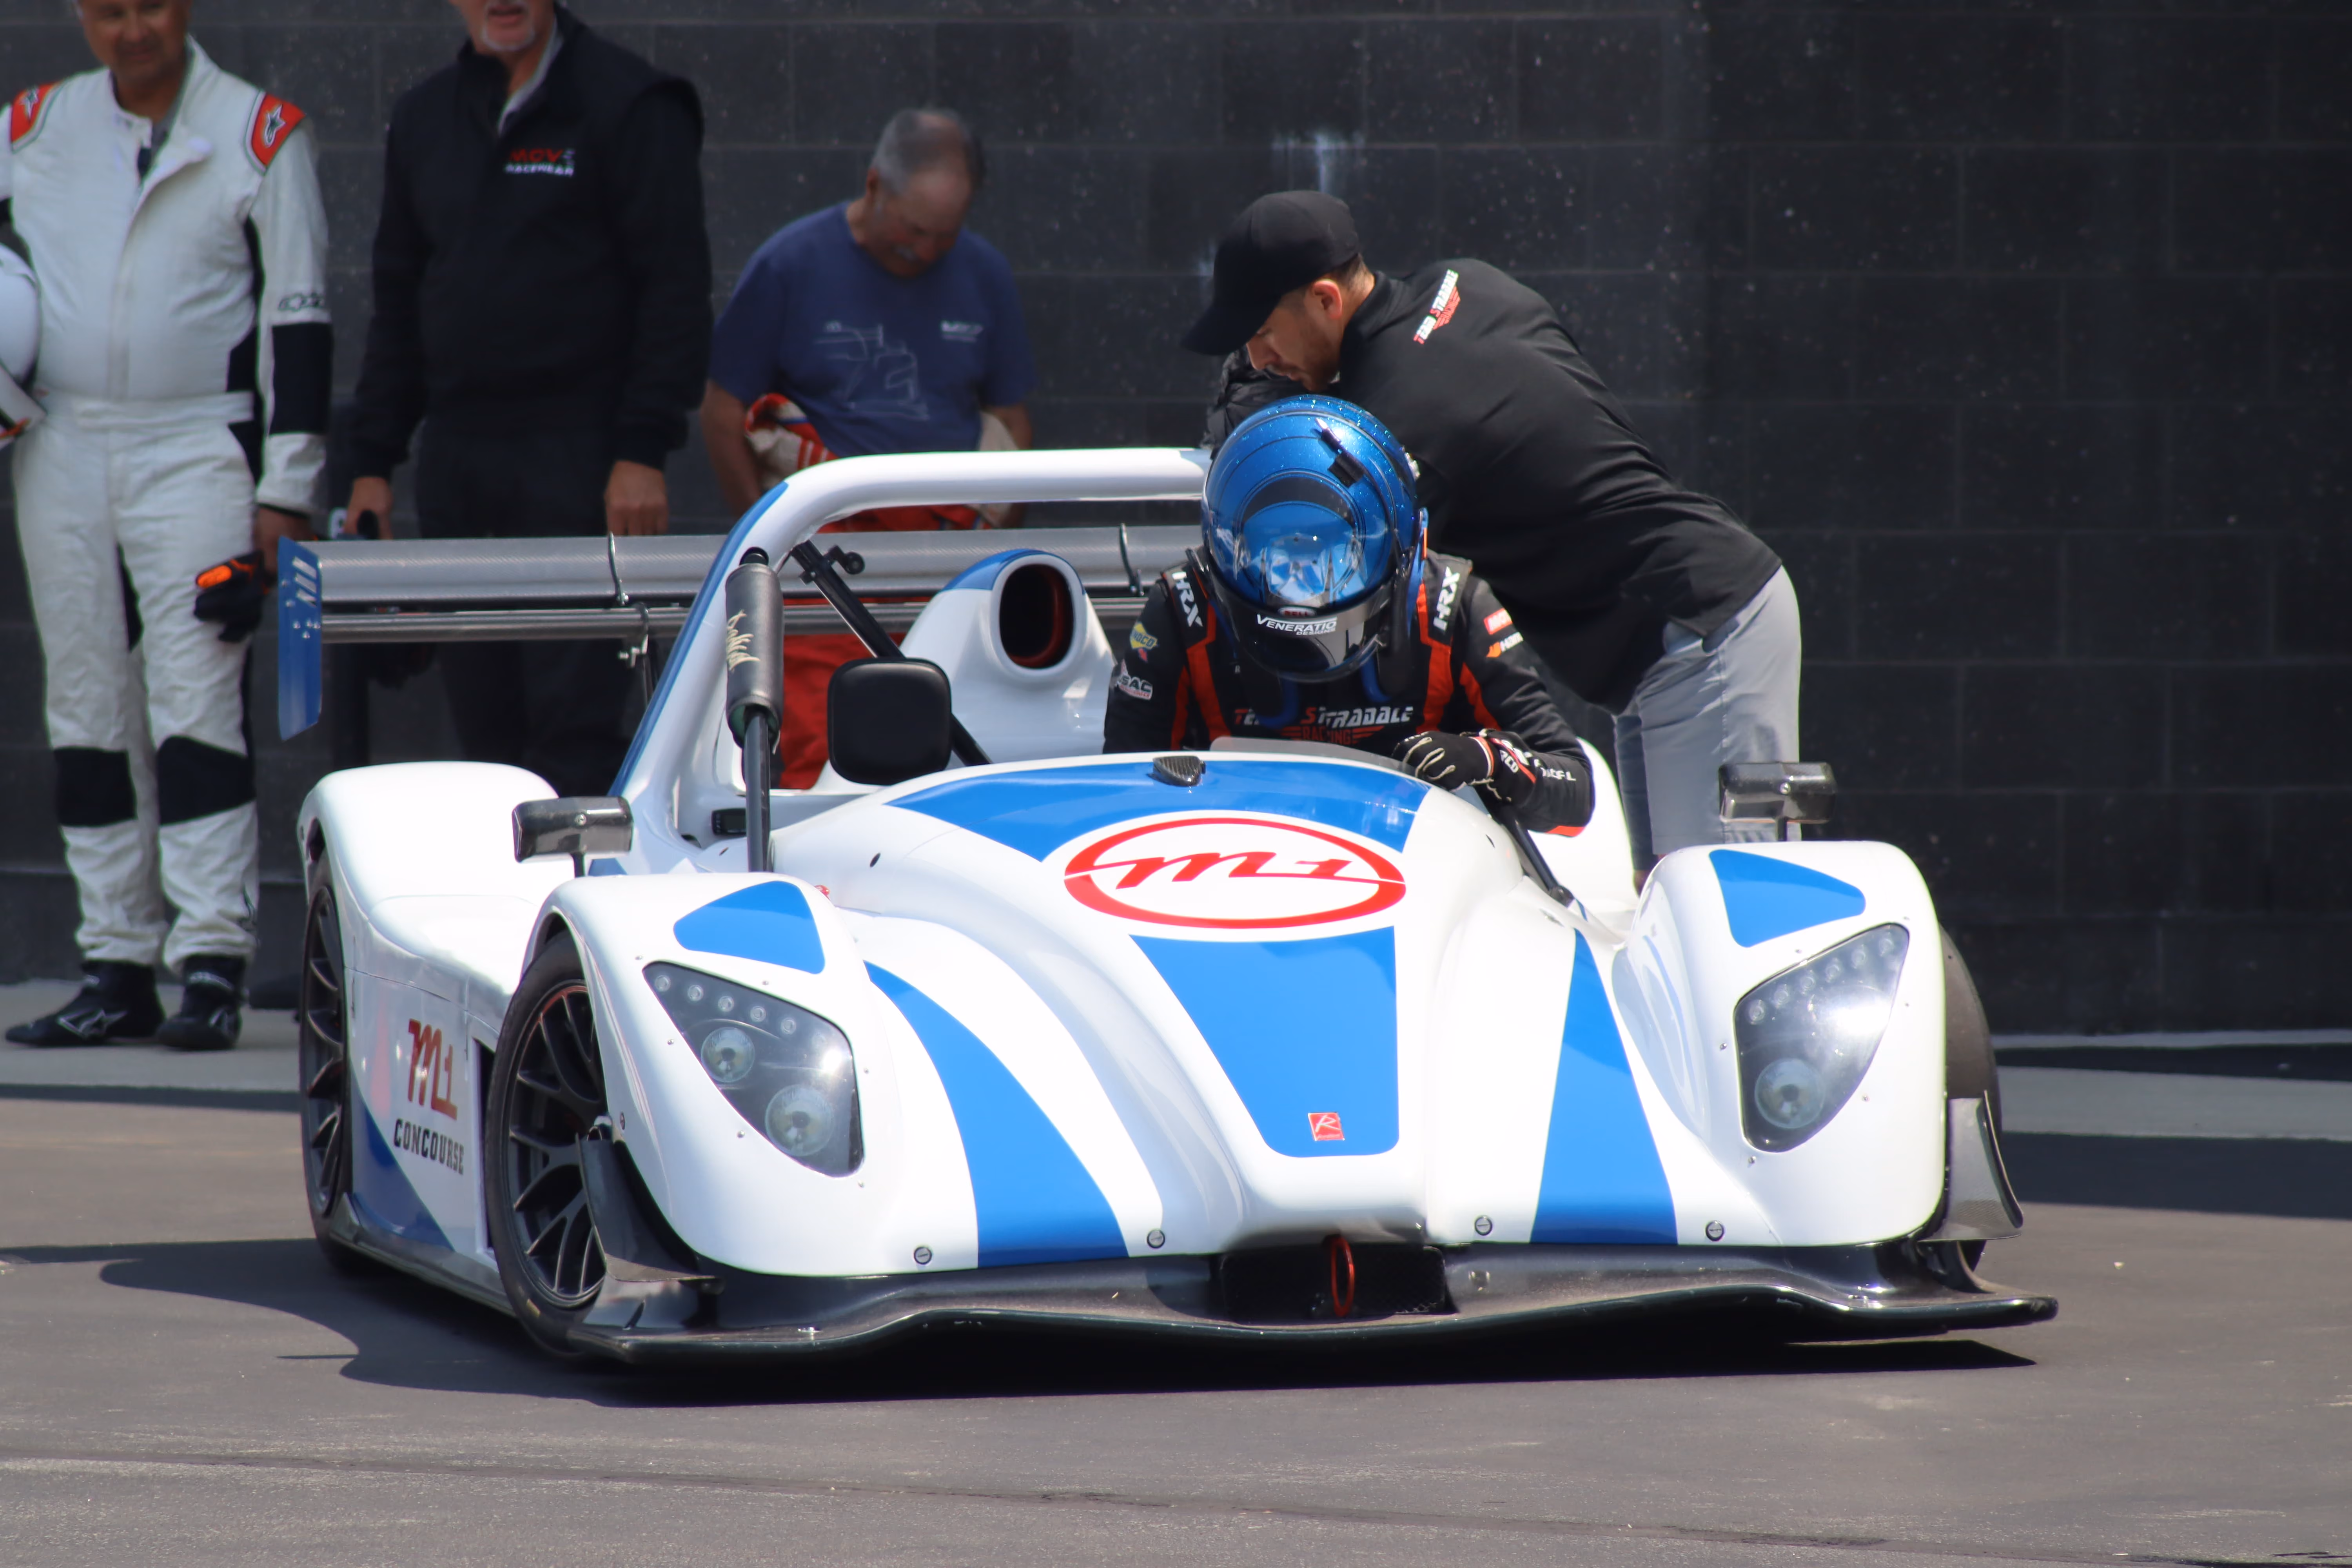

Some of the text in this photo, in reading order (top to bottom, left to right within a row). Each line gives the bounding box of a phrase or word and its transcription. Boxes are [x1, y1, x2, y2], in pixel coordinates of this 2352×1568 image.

[1172, 571, 1203, 627] HRX
[1433, 566, 1460, 632] HRX
[394, 1118, 464, 1175] CONCOURSE
